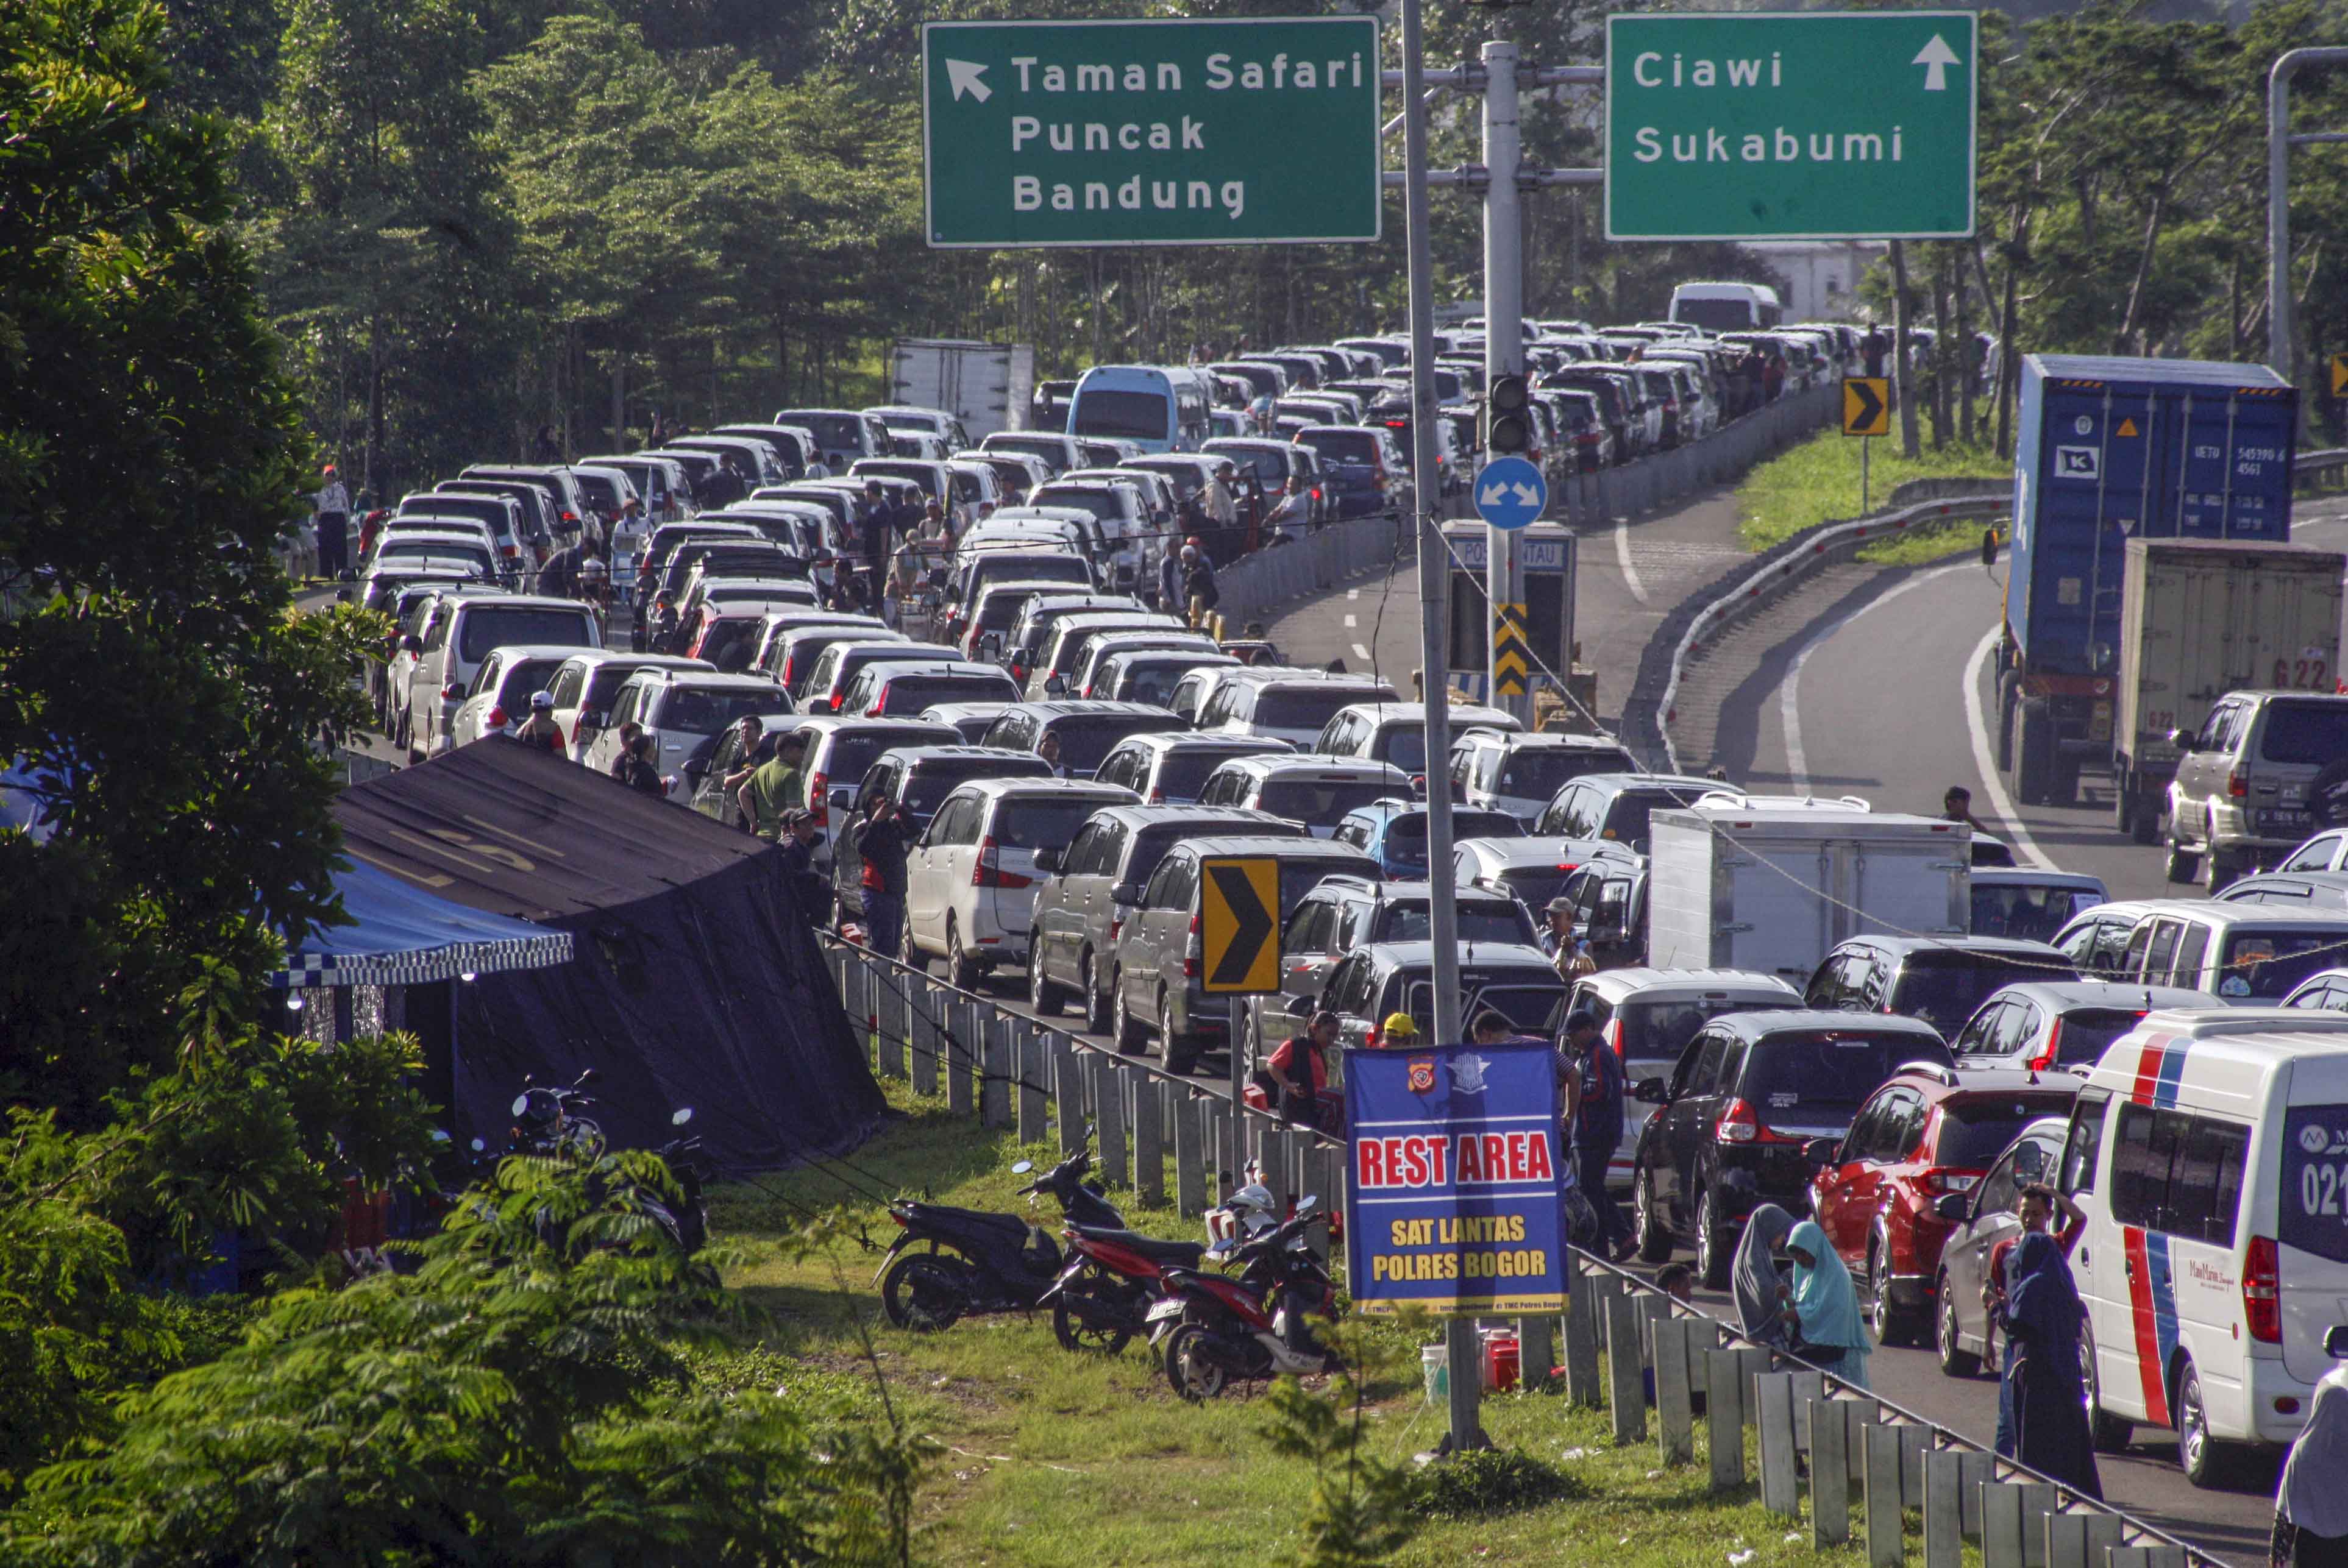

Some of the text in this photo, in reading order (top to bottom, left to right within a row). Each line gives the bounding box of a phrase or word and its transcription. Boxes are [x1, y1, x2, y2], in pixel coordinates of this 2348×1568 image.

[1011, 52, 1363, 93] Taman Safari
[1634, 51, 1781, 87] Ciawi
[1012, 115, 1205, 152] Puncak
[1633, 124, 1903, 163] Sukabumi
[1014, 174, 1245, 220] Bandung
[1357, 1130, 1555, 1189] REST AREA
[1391, 1215, 1526, 1247] SAT LANTAS
[1373, 1250, 1546, 1282] POLRES BOGOR
